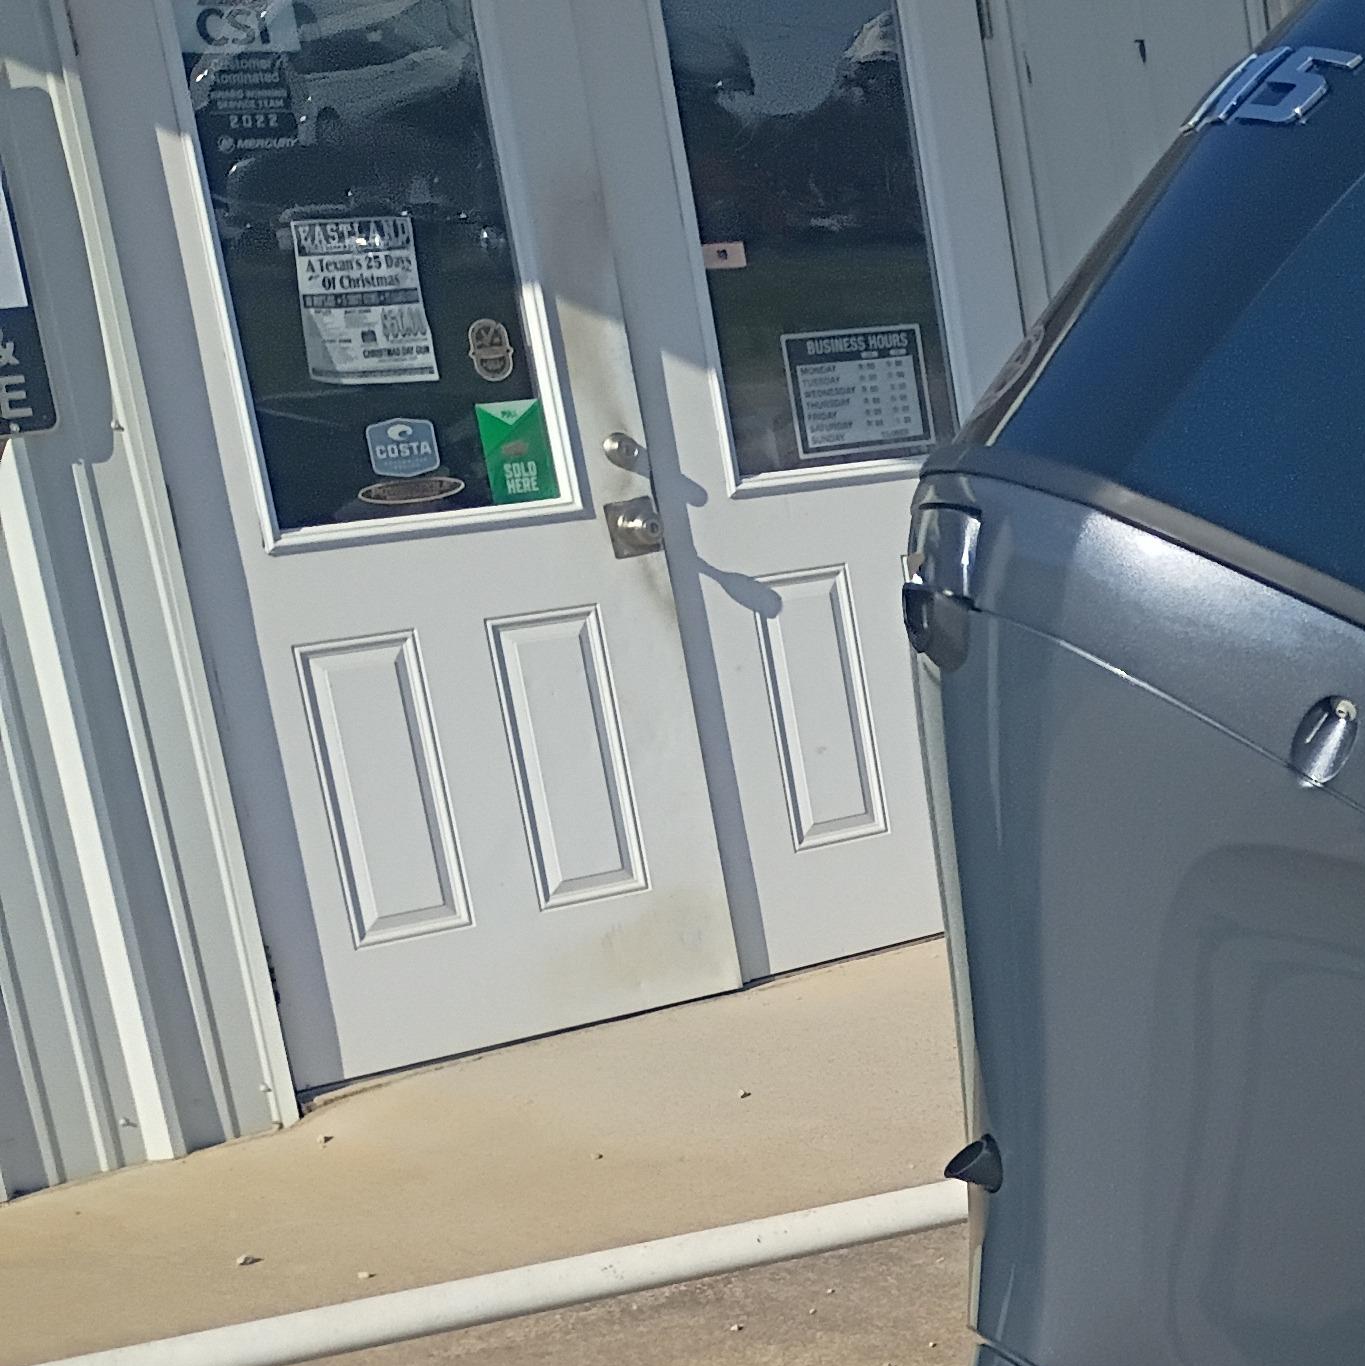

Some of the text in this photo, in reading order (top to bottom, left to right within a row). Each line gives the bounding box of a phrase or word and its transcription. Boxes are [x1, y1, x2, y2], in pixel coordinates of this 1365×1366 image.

[196, 8, 270, 46] CSI
[229, 113, 278, 128] 2022
[307, 254, 412, 272] A Texan's 25 Days
[339, 273, 402, 289] Christmas
[806, 336, 866, 355] BUSINESS
[867, 332, 908, 350] HOURS
[376, 441, 432, 459] COSTA
[503, 461, 537, 478] SOLD
[506, 476, 539, 494] HERE
